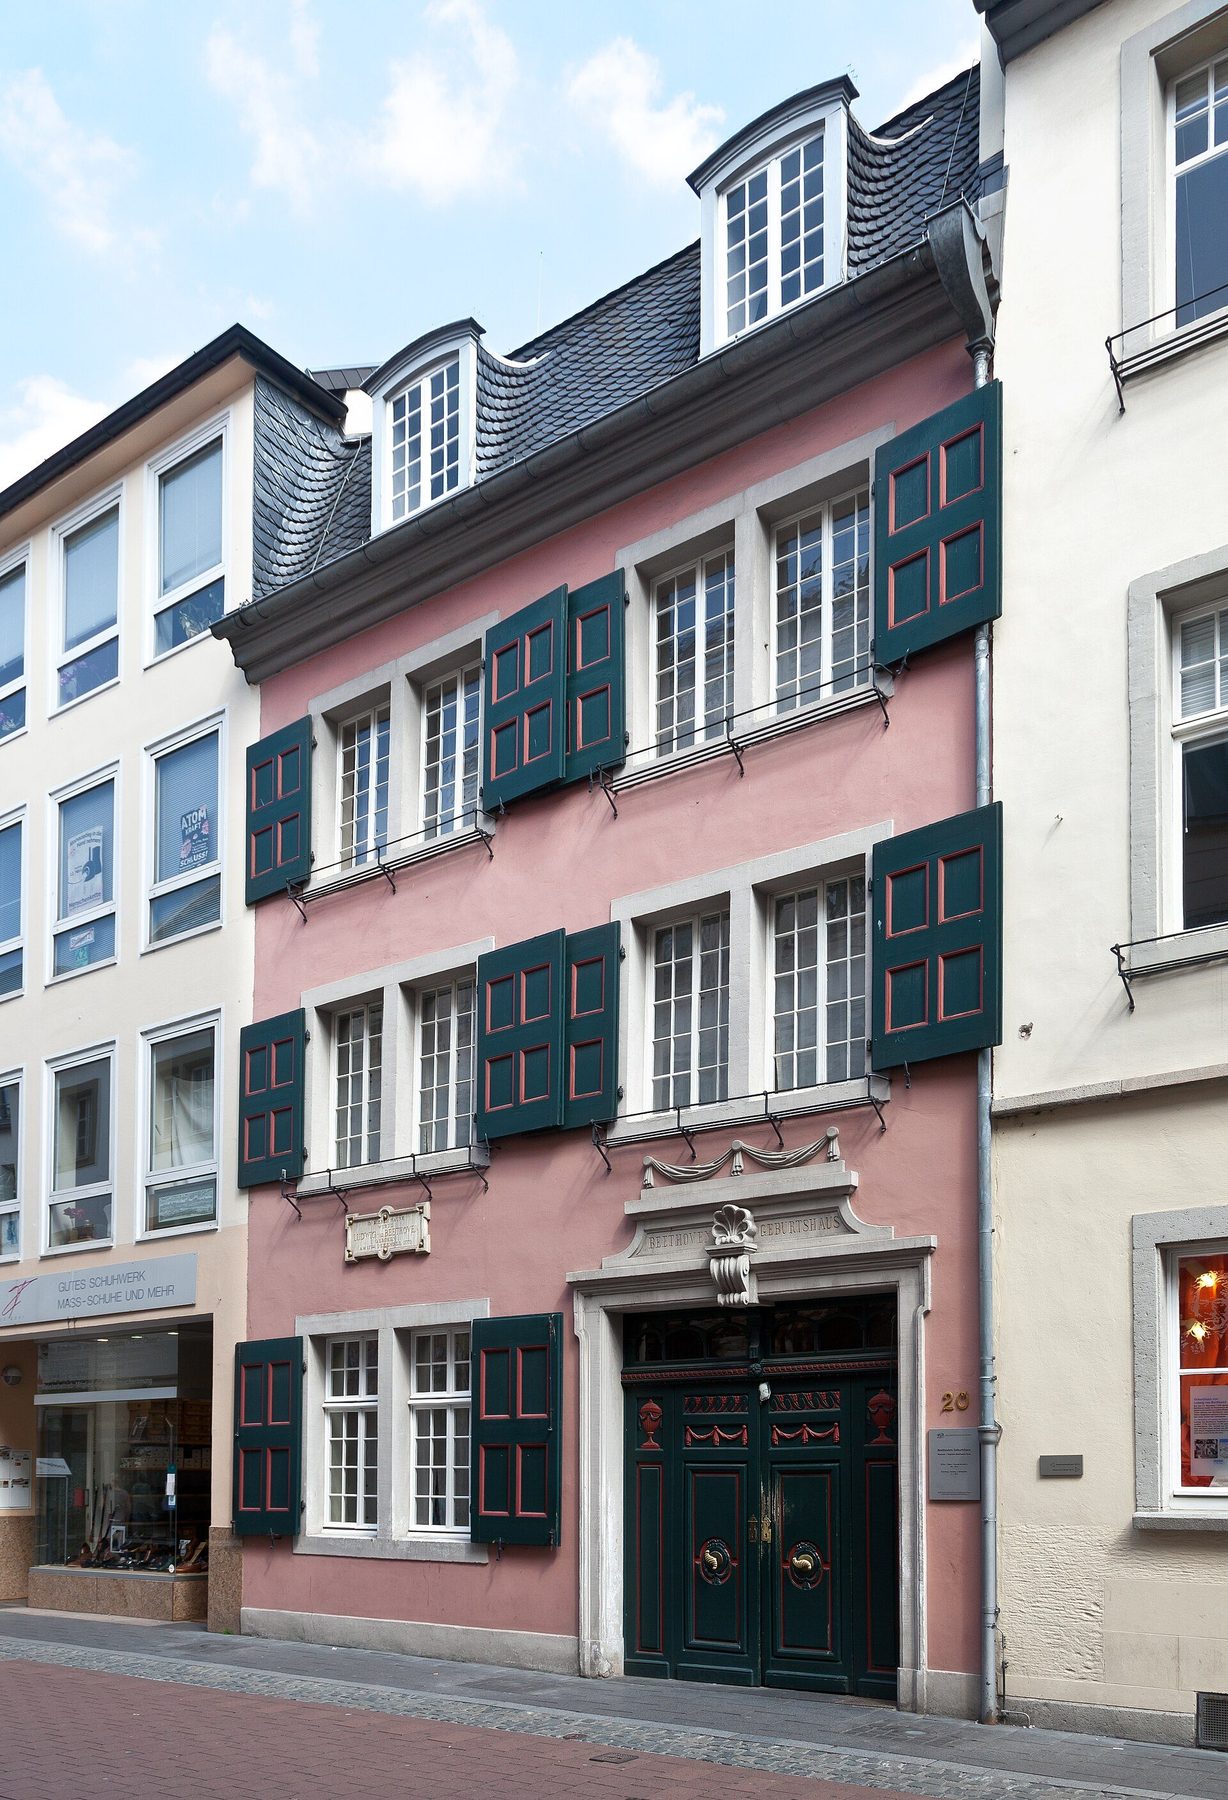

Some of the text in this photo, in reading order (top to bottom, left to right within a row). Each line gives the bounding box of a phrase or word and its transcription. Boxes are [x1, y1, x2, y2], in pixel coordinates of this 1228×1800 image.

[182, 809, 207, 829] ATOM
[760, 1215, 841, 1237] GEBURTSHAUS
[58, 1270, 147, 1293] GUTES SCHUHWERK
[57, 1284, 175, 1310] MASS-SCHUHE UND MEHR
[942, 1391, 970, 1412] 20
